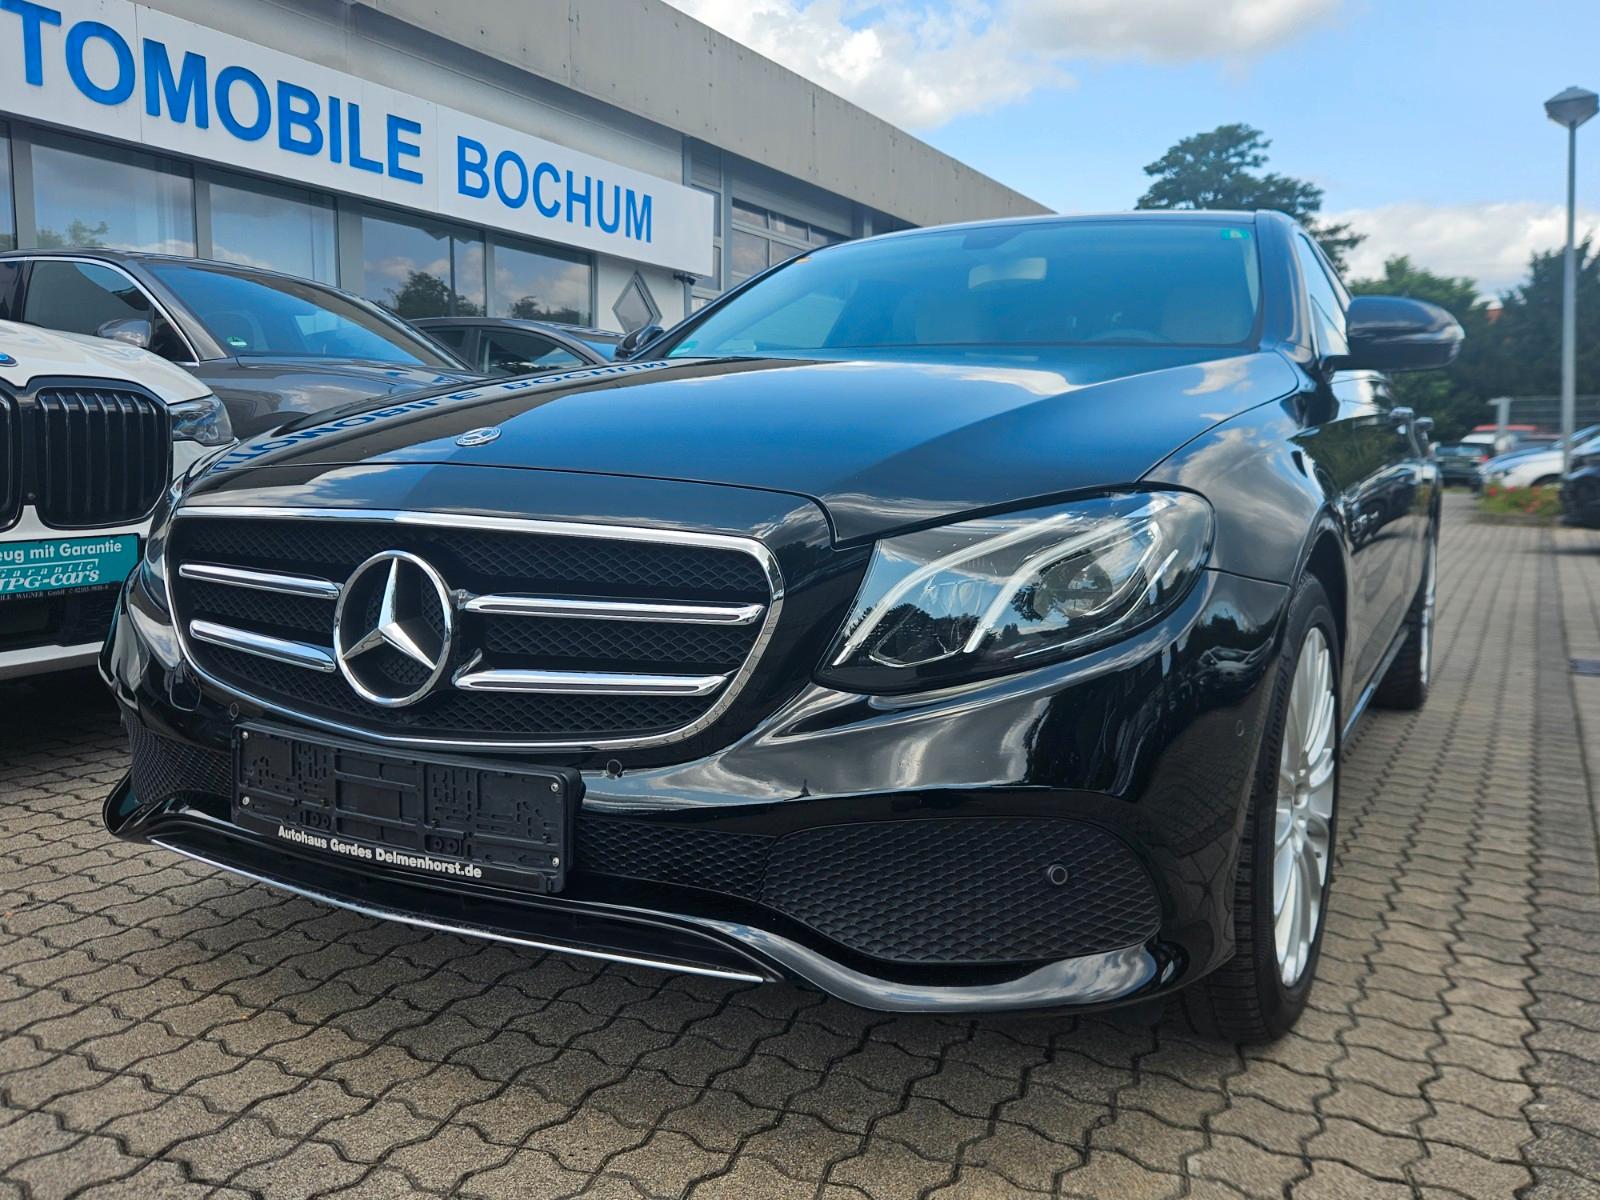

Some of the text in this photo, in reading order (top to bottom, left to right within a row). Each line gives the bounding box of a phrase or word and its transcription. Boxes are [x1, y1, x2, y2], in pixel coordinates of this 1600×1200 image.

[0, 0, 653, 244] TOMOBILE BOCHUM
[30, 544, 55, 559] mit
[60, 540, 122, 556] Garantie
[278, 825, 483, 879] Autohaus Gerdes Delmenhorst.de
